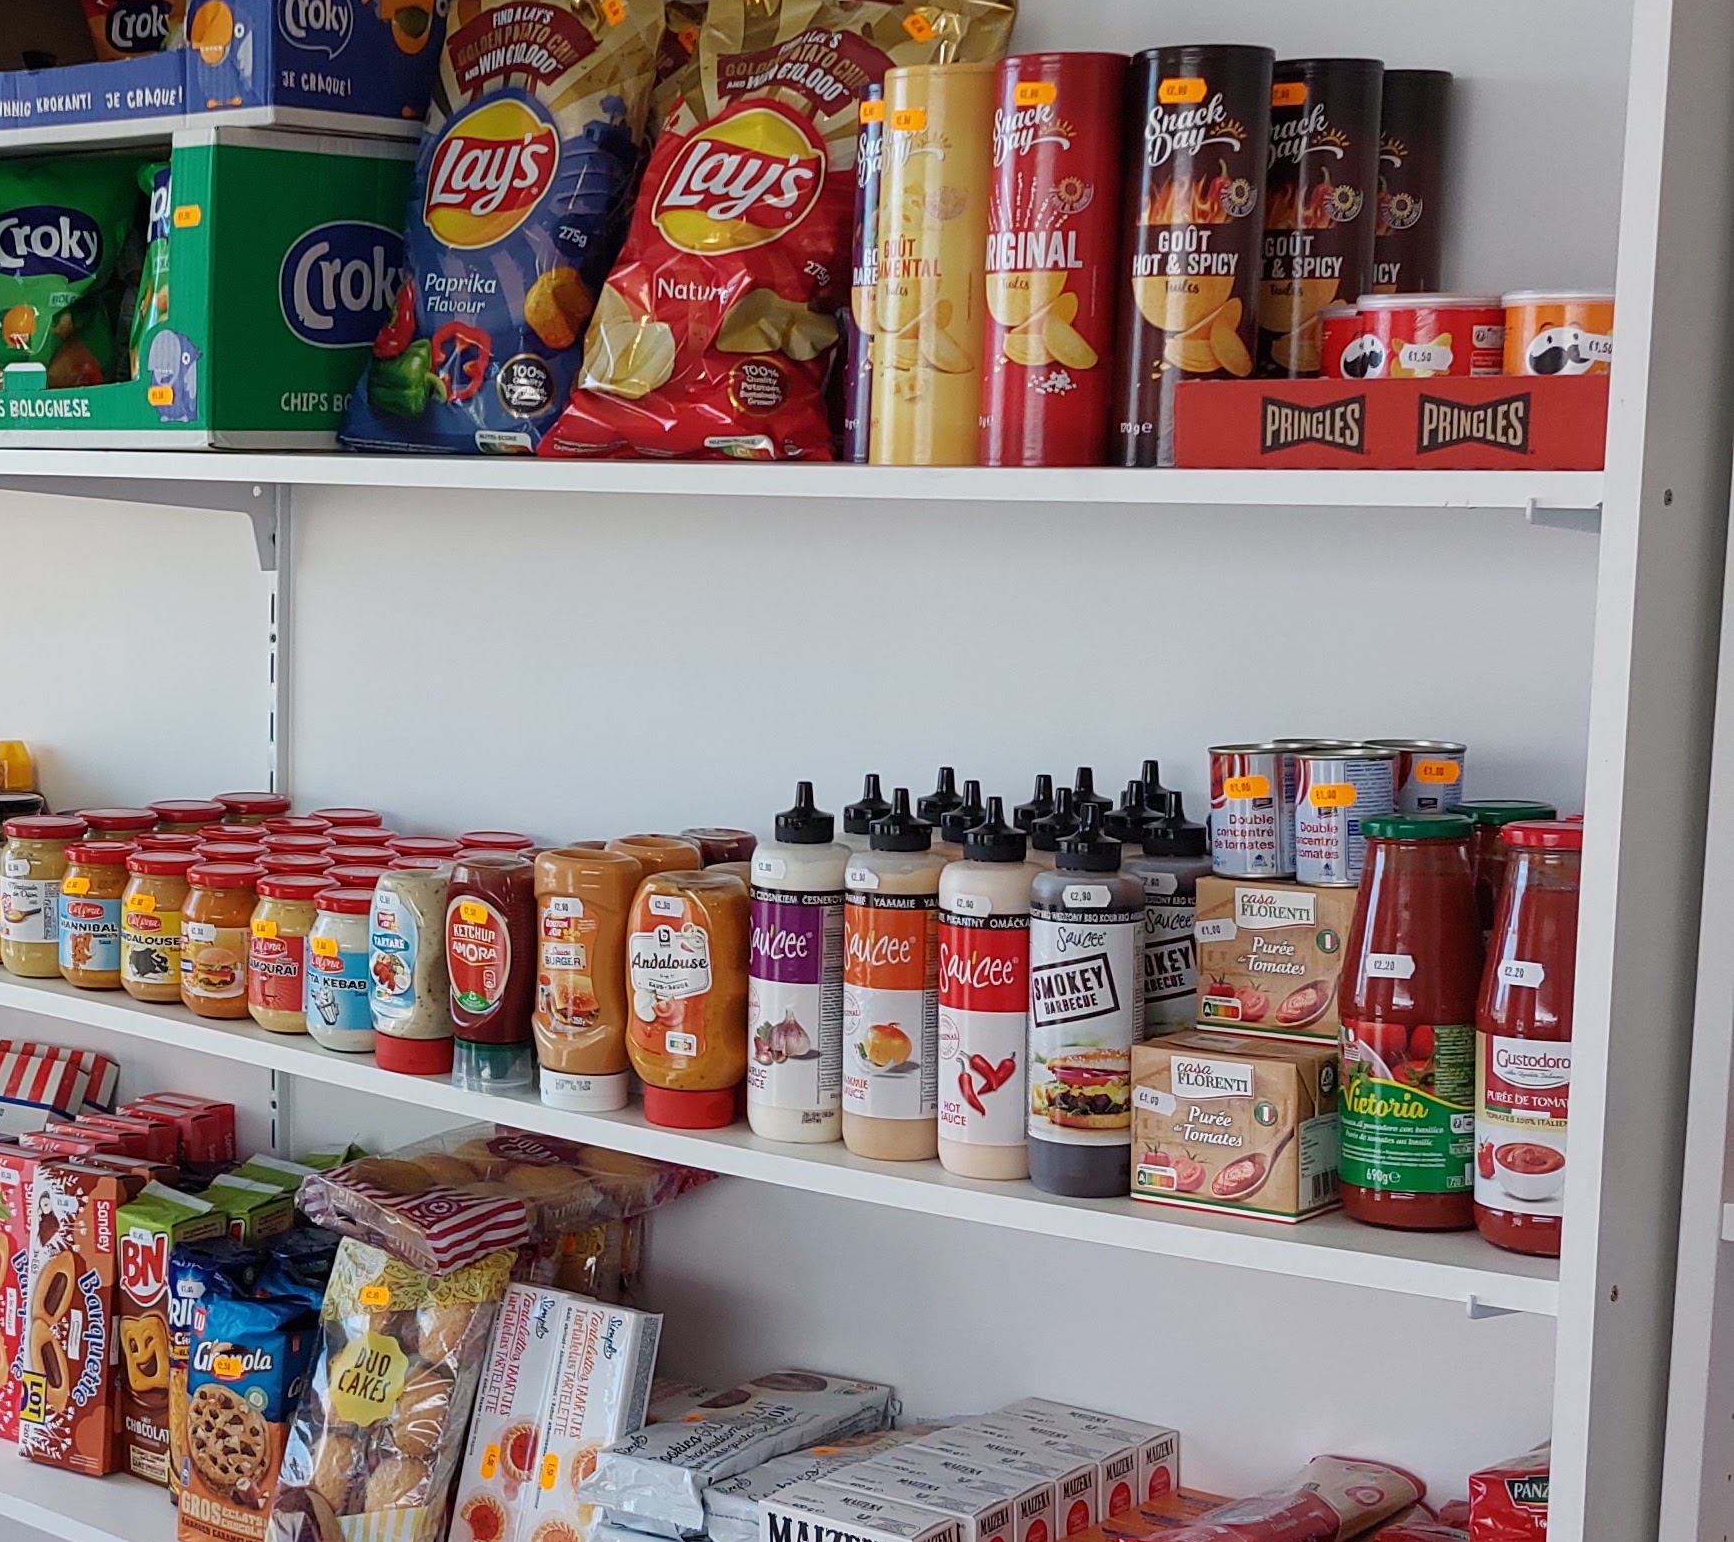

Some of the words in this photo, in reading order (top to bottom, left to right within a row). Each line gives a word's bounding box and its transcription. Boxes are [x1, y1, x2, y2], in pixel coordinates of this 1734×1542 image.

[1146, 93, 1226, 138] Snack
[1148, 127, 1207, 166] Day
[431, 133, 548, 216] Lay's
[663, 141, 812, 221] Lay's
[1157, 228, 1210, 255] GOÛT
[1187, 252, 1237, 275] SPICY
[425, 273, 496, 296] Paprika
[427, 296, 485, 315] Flavour
[10, 398, 91, 418] BOLOGNESE
[1266, 399, 1361, 447] PRINGLES
[1422, 400, 1525, 446] PRINGLES
[1228, 813, 1274, 827] Double
[1227, 838, 1274, 851] tomates
[1241, 904, 1311, 923] FLORENTI
[453, 923, 496, 942] KETCHUP
[453, 943, 496, 959] AMORA
[1252, 937, 1295, 958] Purée
[632, 953, 709, 971] Andalouse
[1245, 955, 1305, 977] Tomates
[1034, 966, 1105, 1000] SMOKEY
[1044, 993, 1098, 1015] BARBECUE
[1497, 1050, 1570, 1073] Gustodoro
[1177, 1071, 1248, 1093] FLORENTI
[1344, 1085, 1428, 1118] Victoria
[1188, 1105, 1232, 1126] Purée
[1182, 1123, 1243, 1147] Tomates
[96, 1199, 113, 1252] Sondey
[121, 1237, 166, 1289] BN
[71, 1269, 101, 1406] Barquette
[353, 1347, 391, 1377] DUO
[338, 1369, 392, 1403] CAKES
[30, 1378, 45, 1422] LOT
[126, 1415, 169, 1441] CHOCOLAT
[181, 1490, 220, 1522] GROS
